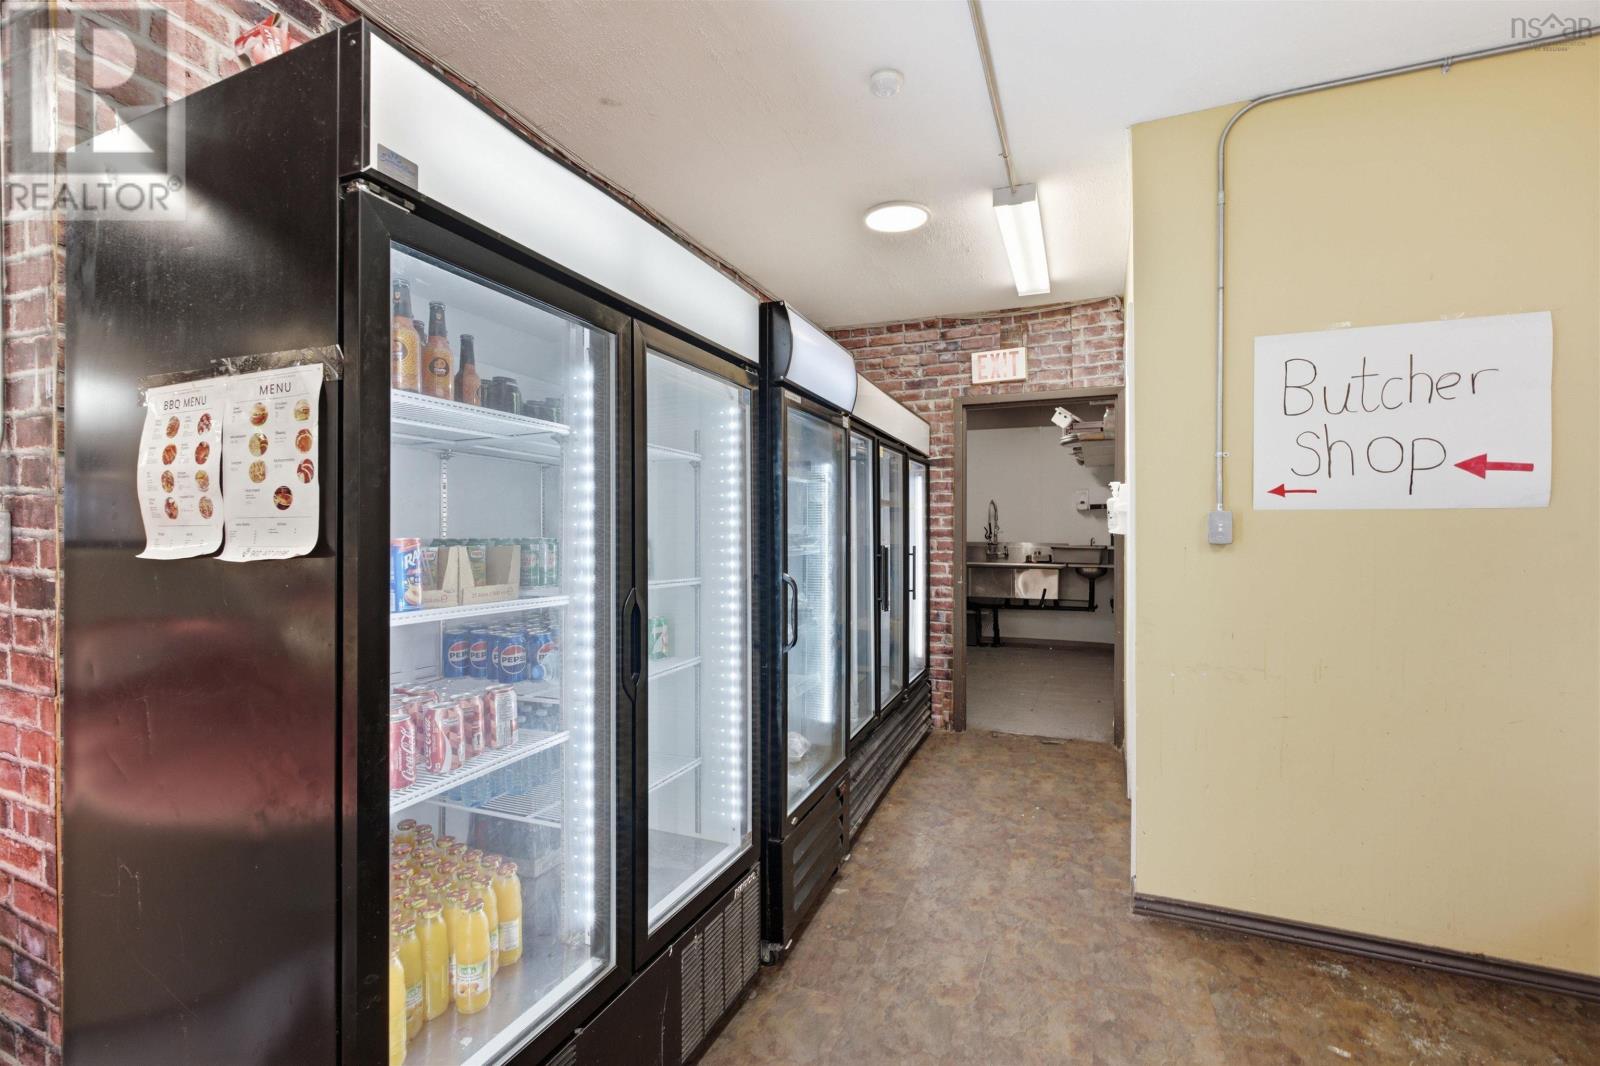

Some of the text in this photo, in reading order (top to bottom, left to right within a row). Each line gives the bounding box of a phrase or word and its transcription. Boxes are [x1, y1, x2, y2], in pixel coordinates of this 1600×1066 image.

[977, 351, 1020, 379] EXIT
[259, 382, 292, 395] MENU
[1283, 354, 1499, 416] Butcher
[163, 396, 207, 411] BBQ MENU
